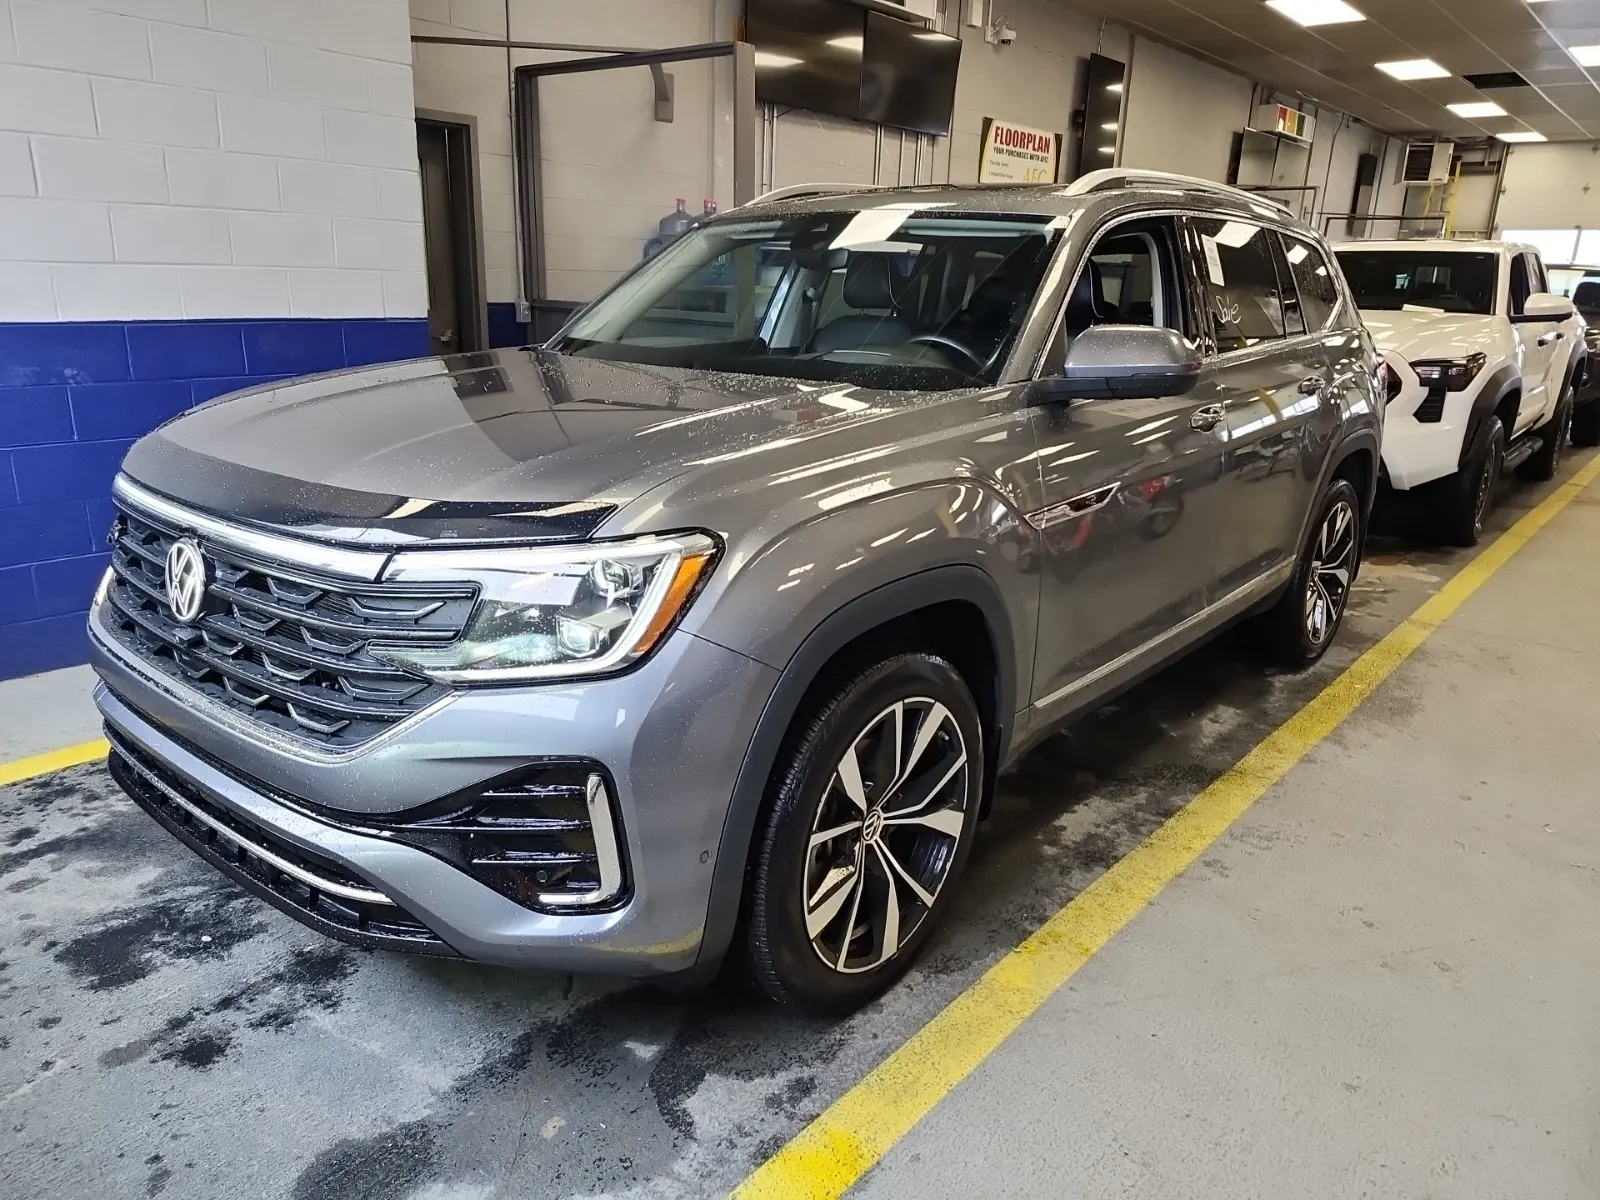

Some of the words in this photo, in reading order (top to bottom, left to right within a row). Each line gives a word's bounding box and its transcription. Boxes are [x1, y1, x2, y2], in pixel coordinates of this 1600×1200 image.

[994, 125, 1051, 154] FLOORPLAN
[993, 146, 1005, 155] YOUR
[1005, 149, 1029, 160] PURCHASES
[1029, 153, 1040, 162] WITH
[1022, 167, 1047, 183] AFC
